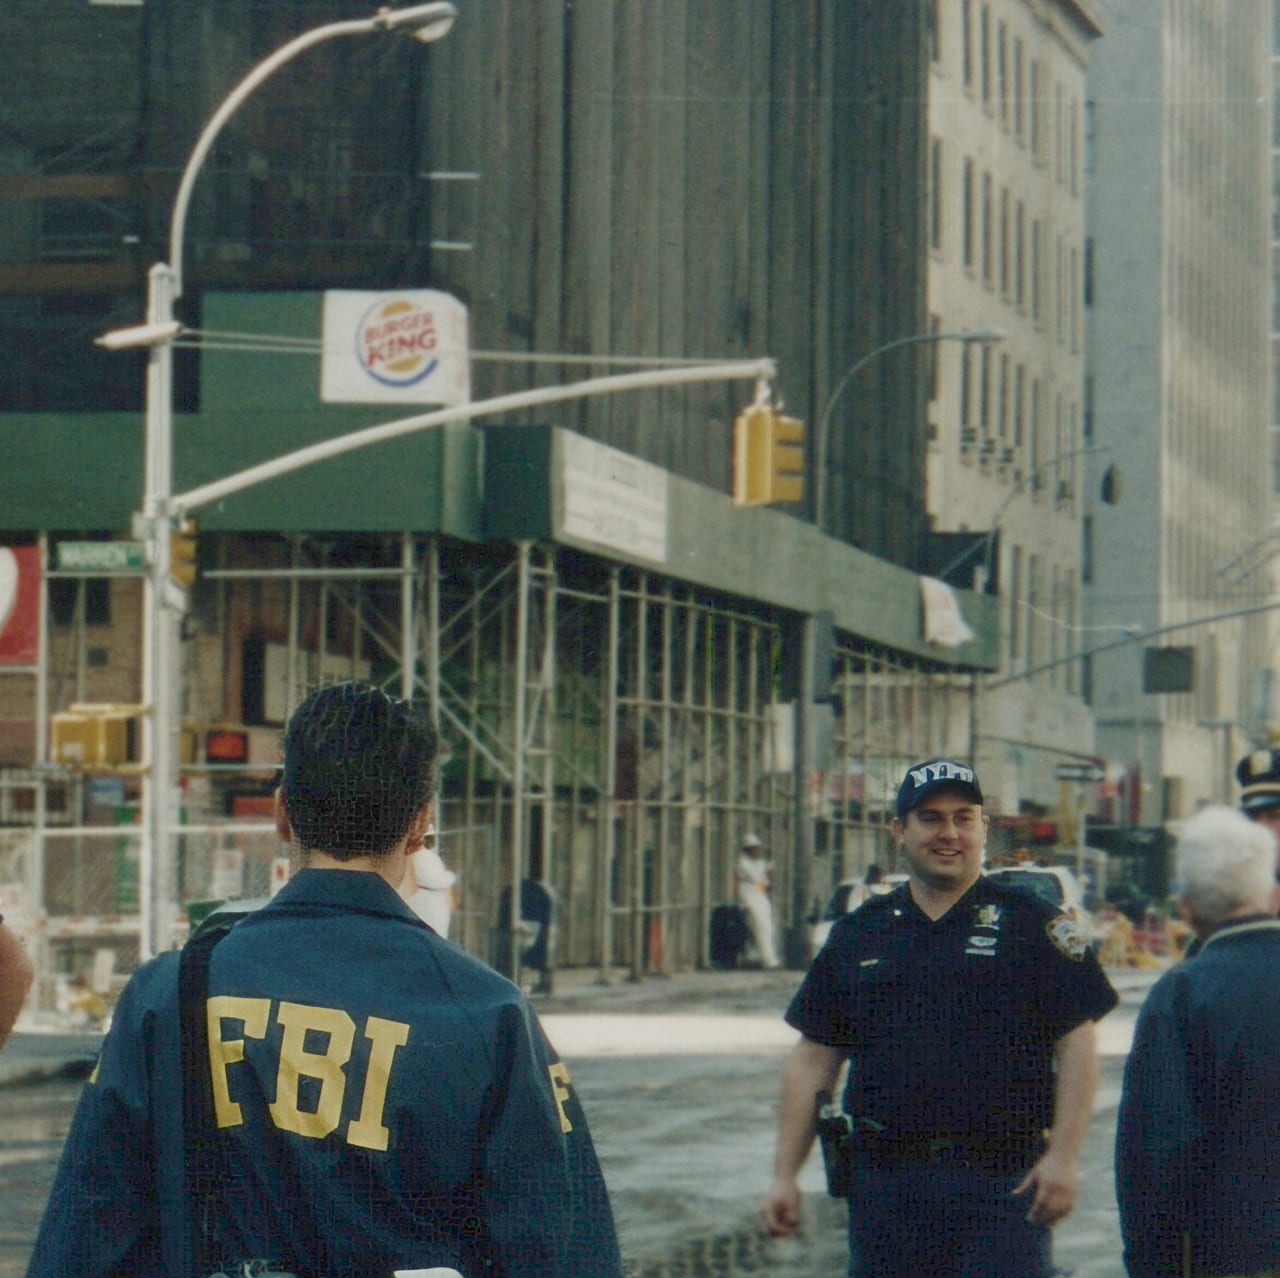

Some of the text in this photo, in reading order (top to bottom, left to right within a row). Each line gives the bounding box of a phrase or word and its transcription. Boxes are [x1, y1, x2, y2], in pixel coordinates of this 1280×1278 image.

[364, 312, 433, 345] BURGER
[366, 329, 438, 369] KING
[909, 761, 975, 788] NYPD
[206, 994, 410, 1152] FBI
